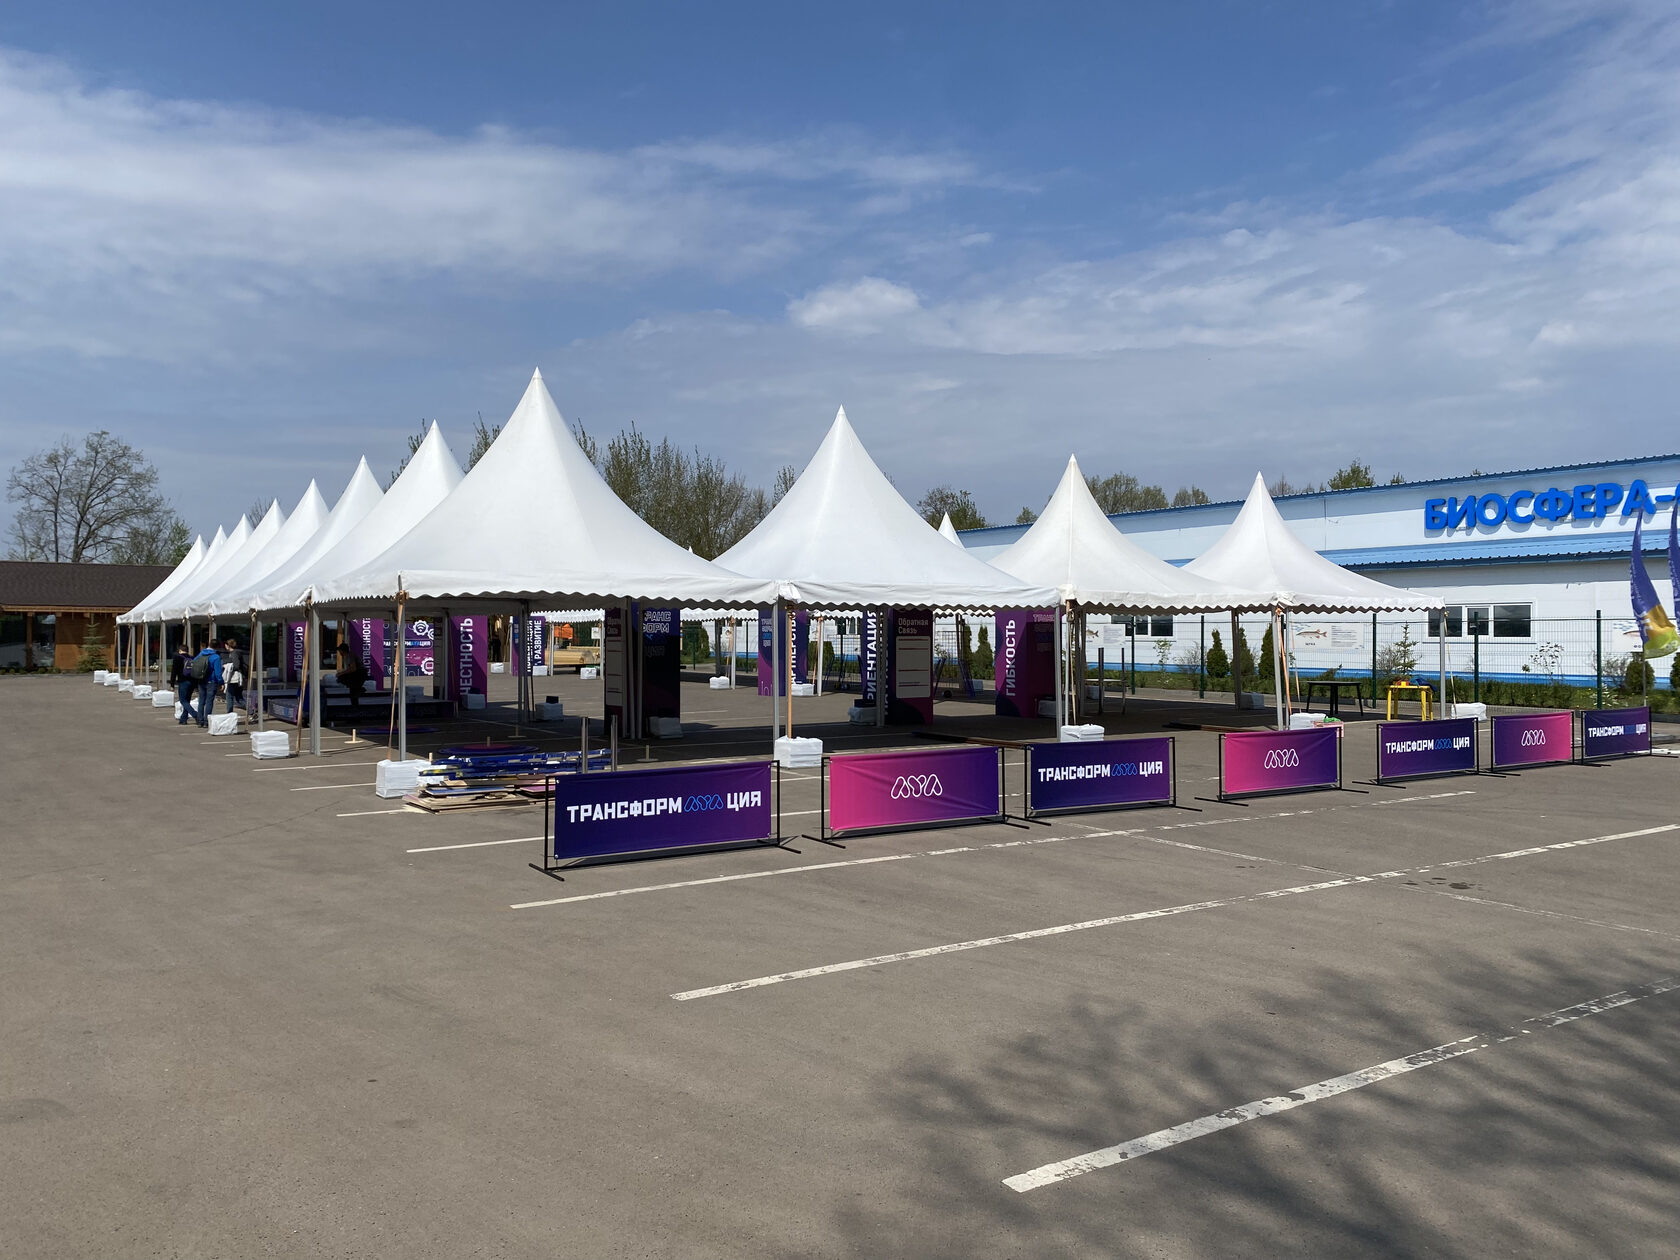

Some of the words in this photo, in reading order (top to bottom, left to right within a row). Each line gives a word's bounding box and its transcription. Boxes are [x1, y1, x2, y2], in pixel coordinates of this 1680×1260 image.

[1425, 480, 1680, 530] БИОСФЕРА-
[643, 611, 671, 622] РАНС
[898, 618, 929, 627] Обратная
[293, 626, 303, 671] ГИБКОСТЬ
[459, 618, 473, 695] ЧЕСТНОСТЬ
[534, 620, 542, 659] РАЗВИТИЕ
[1006, 619, 1016, 697] ГИБКОСТЬ
